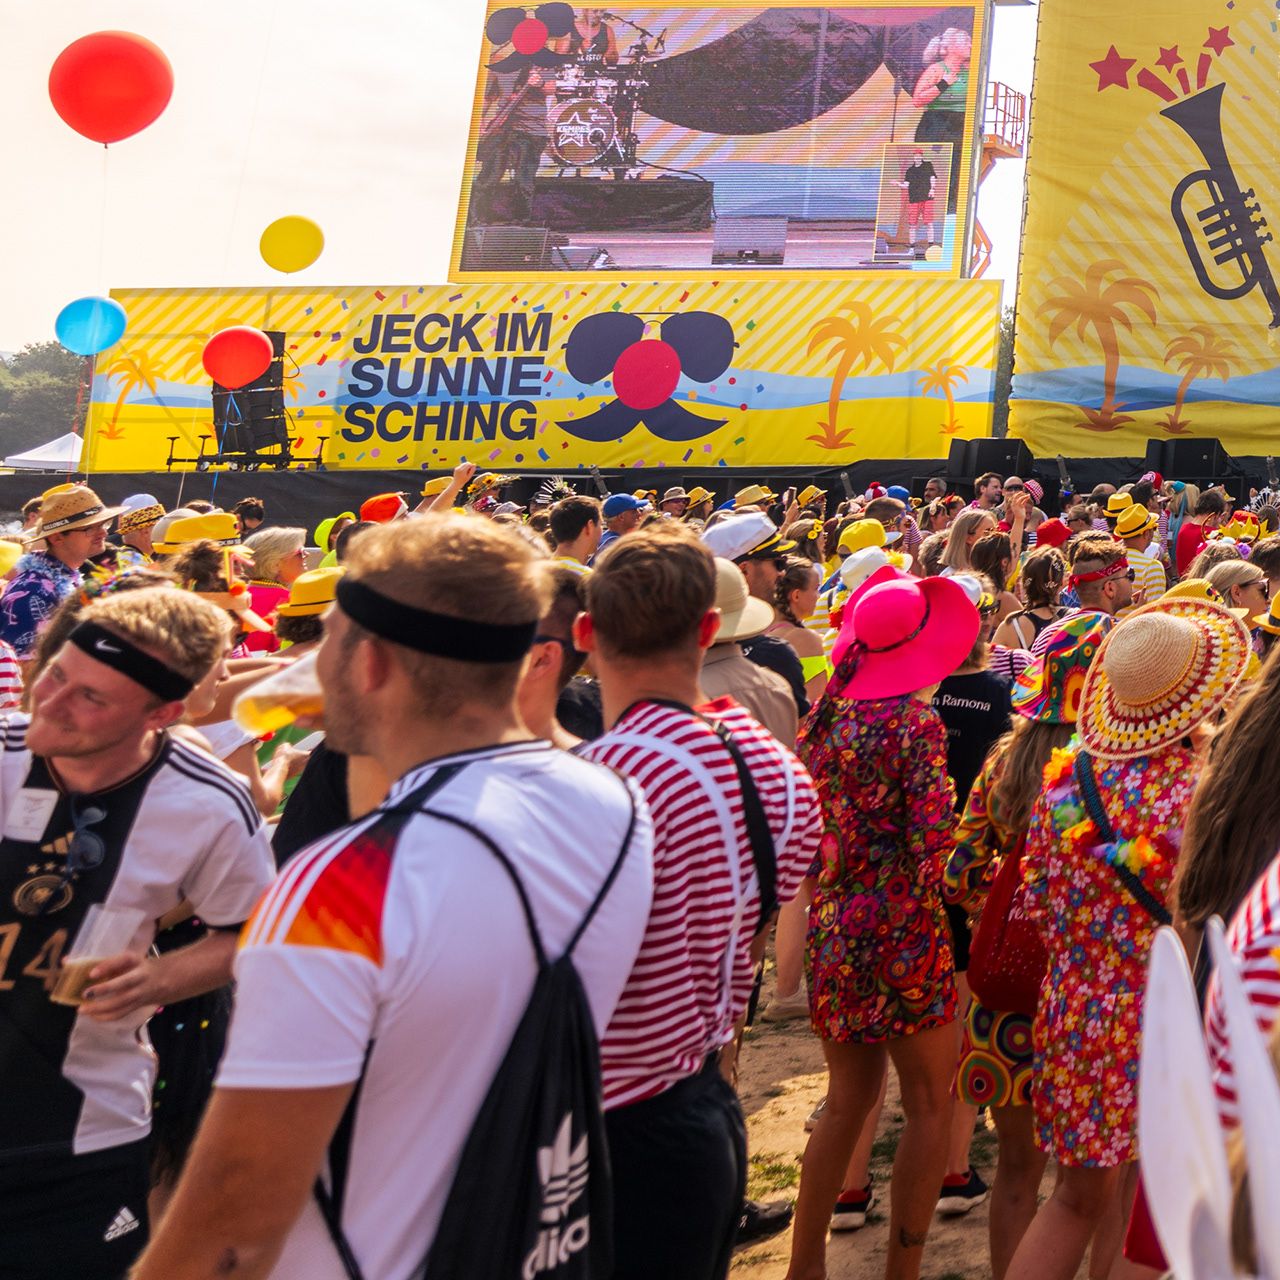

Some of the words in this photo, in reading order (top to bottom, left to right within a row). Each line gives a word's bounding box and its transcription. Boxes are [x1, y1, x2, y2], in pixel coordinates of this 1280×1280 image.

[353, 313, 491, 354] JECK
[495, 313, 553, 351] IM
[348, 357, 545, 398] SUNNE
[341, 400, 537, 442] SCHING
[942, 694, 992, 712] Ramona
